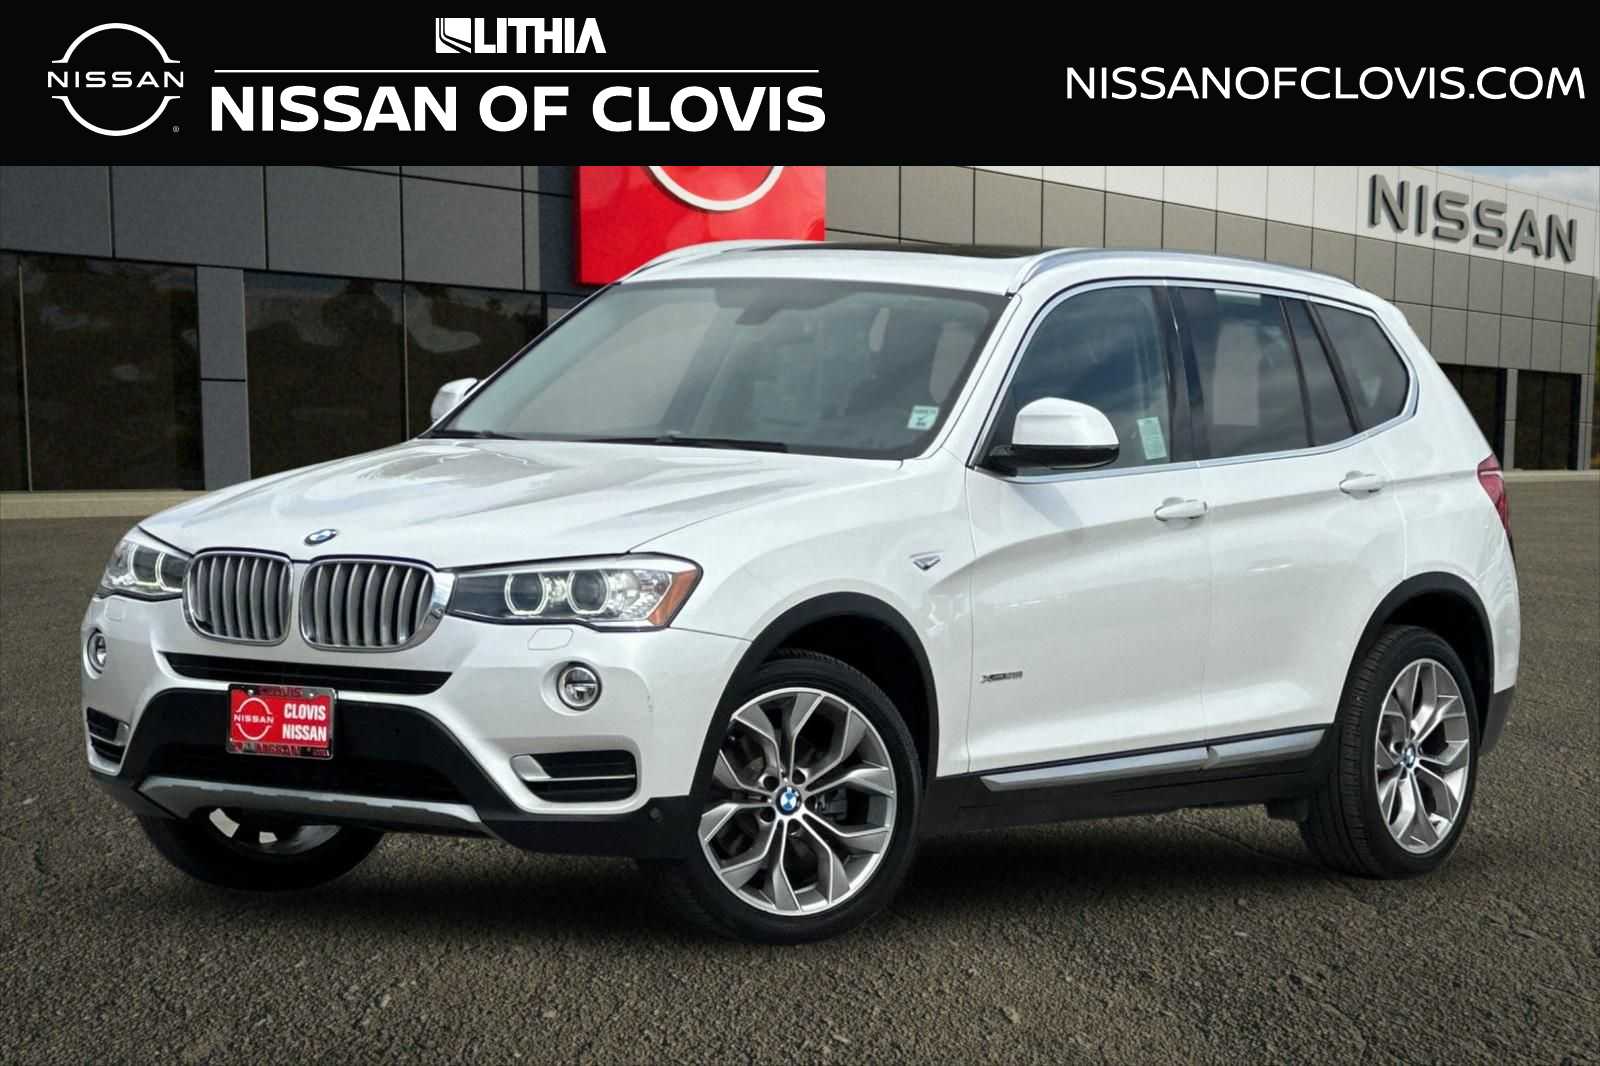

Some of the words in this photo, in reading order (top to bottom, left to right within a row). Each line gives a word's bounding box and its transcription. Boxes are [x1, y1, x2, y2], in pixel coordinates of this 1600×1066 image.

[1368, 173, 1578, 263] NISSAN
[233, 714, 274, 724] NISSAN
[284, 702, 327, 721] CLOVIS
[282, 723, 327, 742] NISSAN
